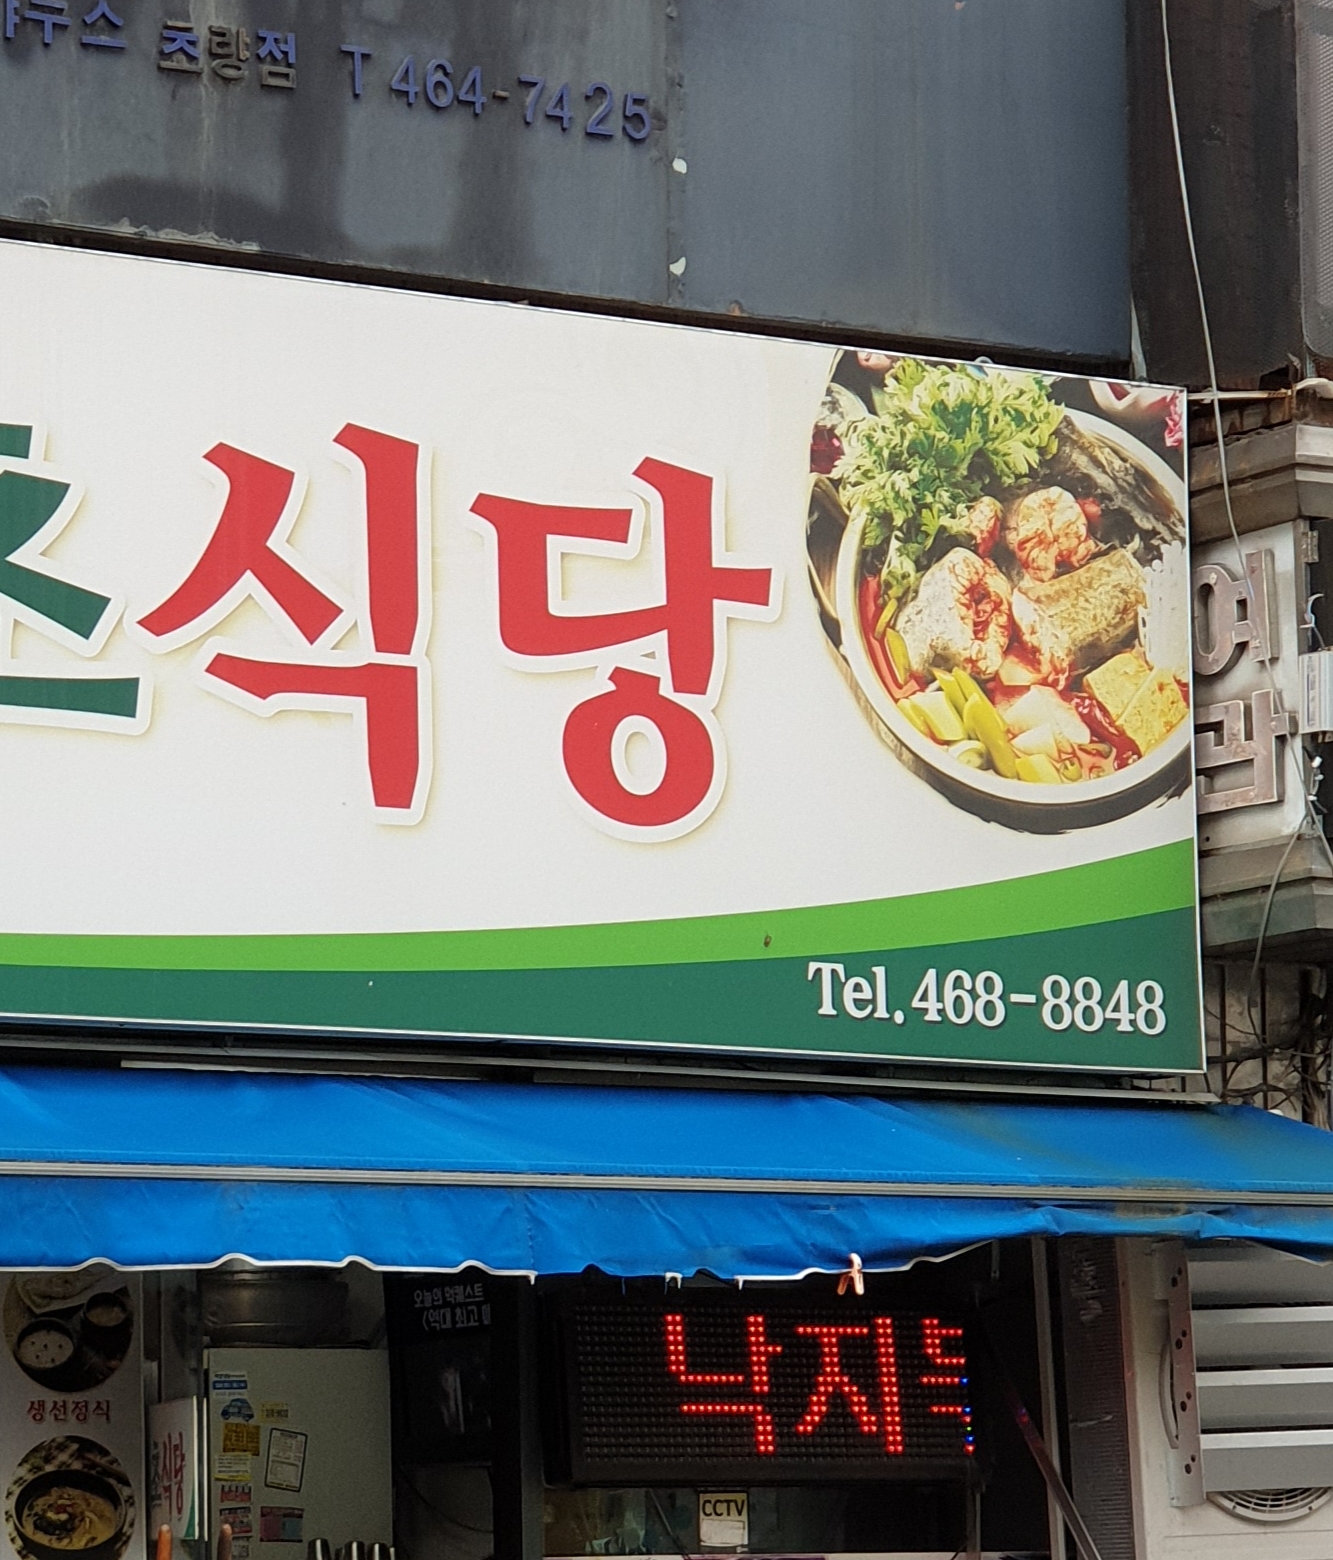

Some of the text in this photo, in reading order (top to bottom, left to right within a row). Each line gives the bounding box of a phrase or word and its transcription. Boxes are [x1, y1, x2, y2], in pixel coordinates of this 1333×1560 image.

[158, 21, 296, 89] 초량점
[340, 44, 373, 97] T
[390, 55, 653, 141] 464-7425
[26, 1400, 112, 1424] 생선정식
[701, 1499, 745, 1518] CCTV
